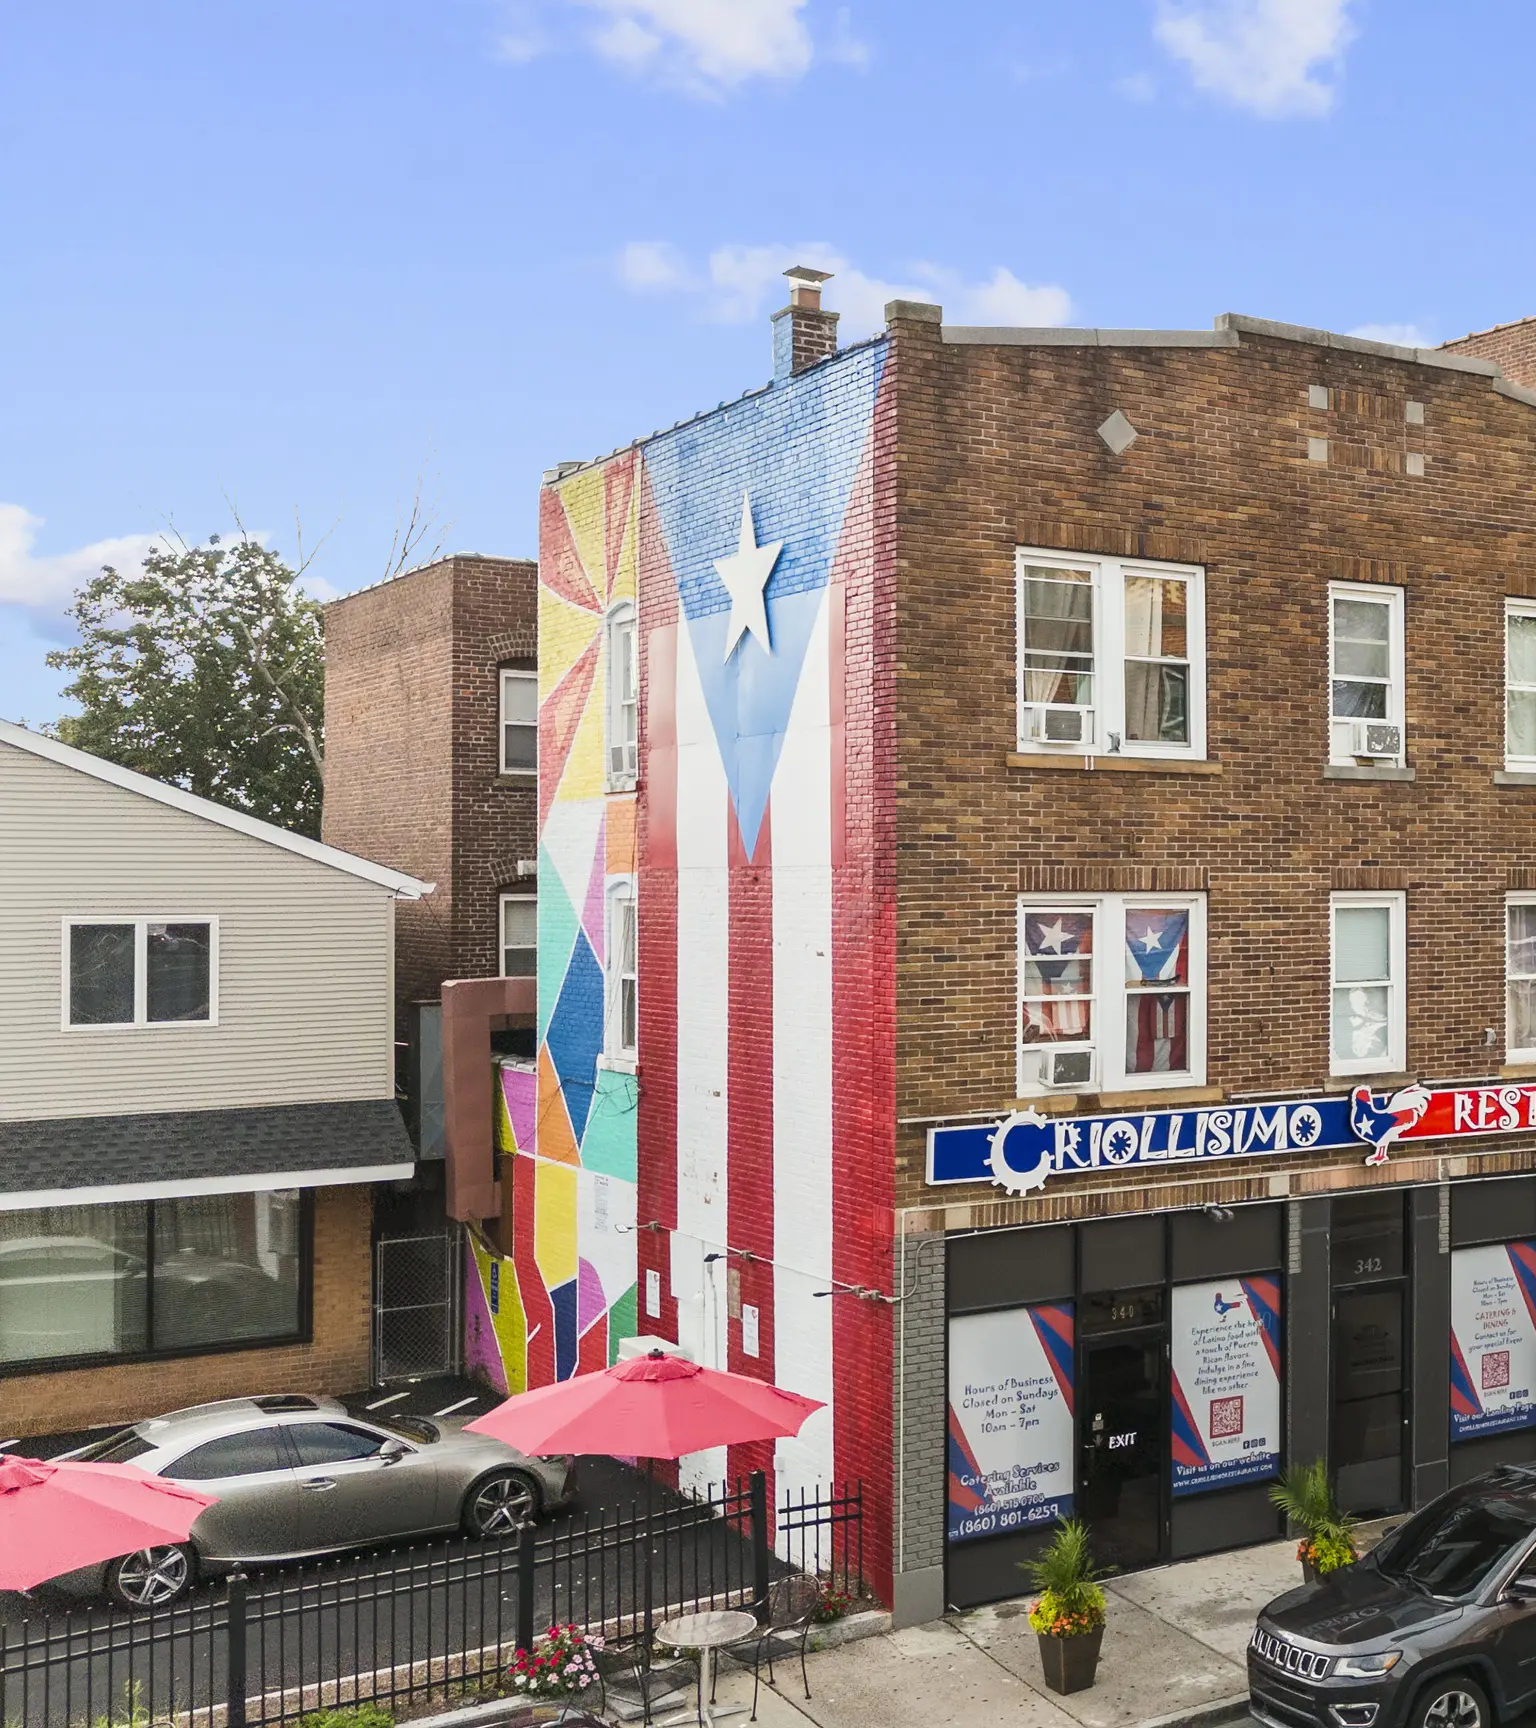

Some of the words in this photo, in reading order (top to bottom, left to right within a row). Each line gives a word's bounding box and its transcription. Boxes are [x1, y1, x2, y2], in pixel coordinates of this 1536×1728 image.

[983, 1104, 1322, 1197] CRIOLLISIMO
[1354, 1257, 1382, 1274] 342
[1112, 1305, 1134, 1320] 340
[1475, 1308, 1510, 1320] CATERING
[1191, 1324, 1232, 1337] Experience
[1234, 1321, 1246, 1330] the
[1483, 1319, 1509, 1330] DINING
[1193, 1336, 1202, 1346] of
[1202, 1334, 1225, 1344] Latino
[1227, 1331, 1244, 1341] food
[1474, 1331, 1499, 1340] Contact
[1507, 1328, 1517, 1336] for
[1202, 1345, 1222, 1353] touch
[1224, 1342, 1233, 1351] of
[1233, 1340, 1258, 1350] Puerto
[1468, 1344, 1483, 1354] your
[1484, 1338, 1505, 1349] special
[1505, 1336, 1523, 1345] Event
[1199, 1365, 1226, 1375] Indulge
[1241, 1360, 1255, 1370] fine
[1202, 1356, 1223, 1365] Rican
[965, 1384, 995, 1396] Hours
[998, 1378, 1009, 1391] of
[1011, 1376, 1053, 1389] Business
[1194, 1376, 1217, 1386] dining
[1219, 1371, 1259, 1384] experience
[962, 1394, 998, 1409] Closed
[1001, 1396, 1014, 1404] on
[1016, 1388, 1058, 1402] Sundays
[1202, 1386, 1215, 1395] like
[985, 1409, 1008, 1420] Mon
[1019, 1403, 1036, 1415] Sat
[1453, 1413, 1470, 1423] Visit
[1471, 1412, 1485, 1420] our
[1486, 1404, 1515, 1418] Landing
[1515, 1401, 1534, 1412] Page
[981, 1423, 1007, 1434] 10am
[1019, 1417, 1040, 1431] 7pm
[1109, 1432, 1137, 1449] EXIT
[1176, 1466, 1196, 1476] Visit
[1209, 1462, 1221, 1470] on
[1222, 1459, 1236, 1468] our
[1239, 1451, 1271, 1465] website
[960, 1470, 1011, 1487] Catering
[1012, 1462, 1060, 1479] Services
[983, 1477, 1037, 1498] Available
[974, 1500, 1001, 1516] (860)
[960, 1515, 996, 1536] (860)
[1000, 1504, 1059, 1527] 801-6259
